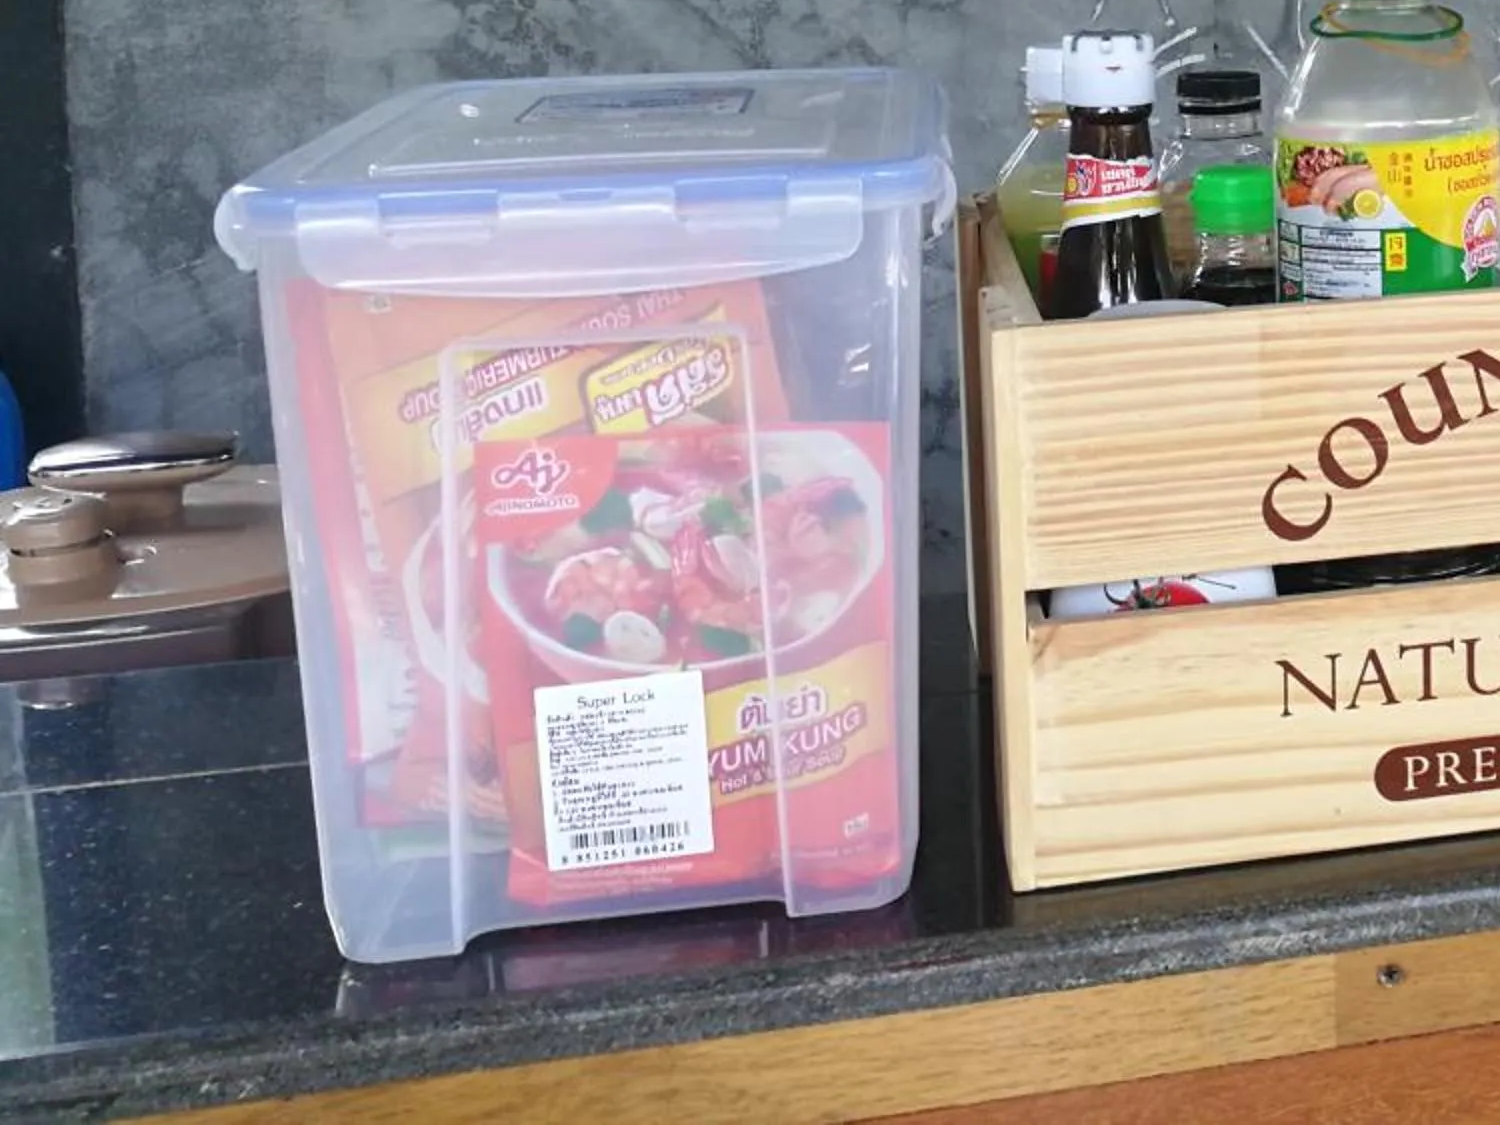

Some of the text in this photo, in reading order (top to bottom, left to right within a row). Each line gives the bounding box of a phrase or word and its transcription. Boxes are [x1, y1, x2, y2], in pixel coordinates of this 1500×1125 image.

[577, 689, 656, 710] Super Lock
[721, 775, 748, 793] Hot
